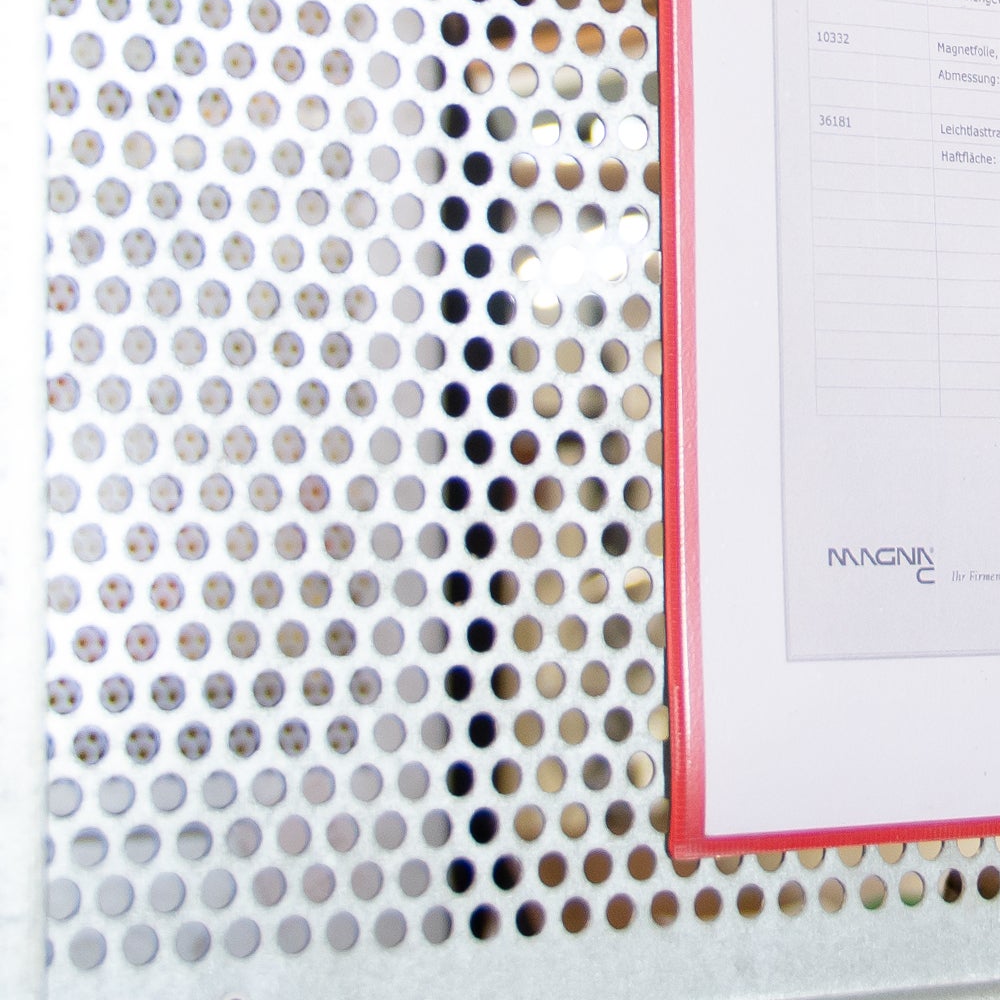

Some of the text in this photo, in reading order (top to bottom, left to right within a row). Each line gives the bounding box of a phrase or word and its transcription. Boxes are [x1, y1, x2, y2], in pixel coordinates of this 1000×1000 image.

[817, 32, 849, 44] 10332
[937, 42, 998, 60] Magnetfolie,
[939, 70, 1000, 86] Abmessung:
[819, 115, 851, 128] 36181
[941, 151, 996, 165] Haftfläche:
[828, 547, 934, 566] MAGNA
